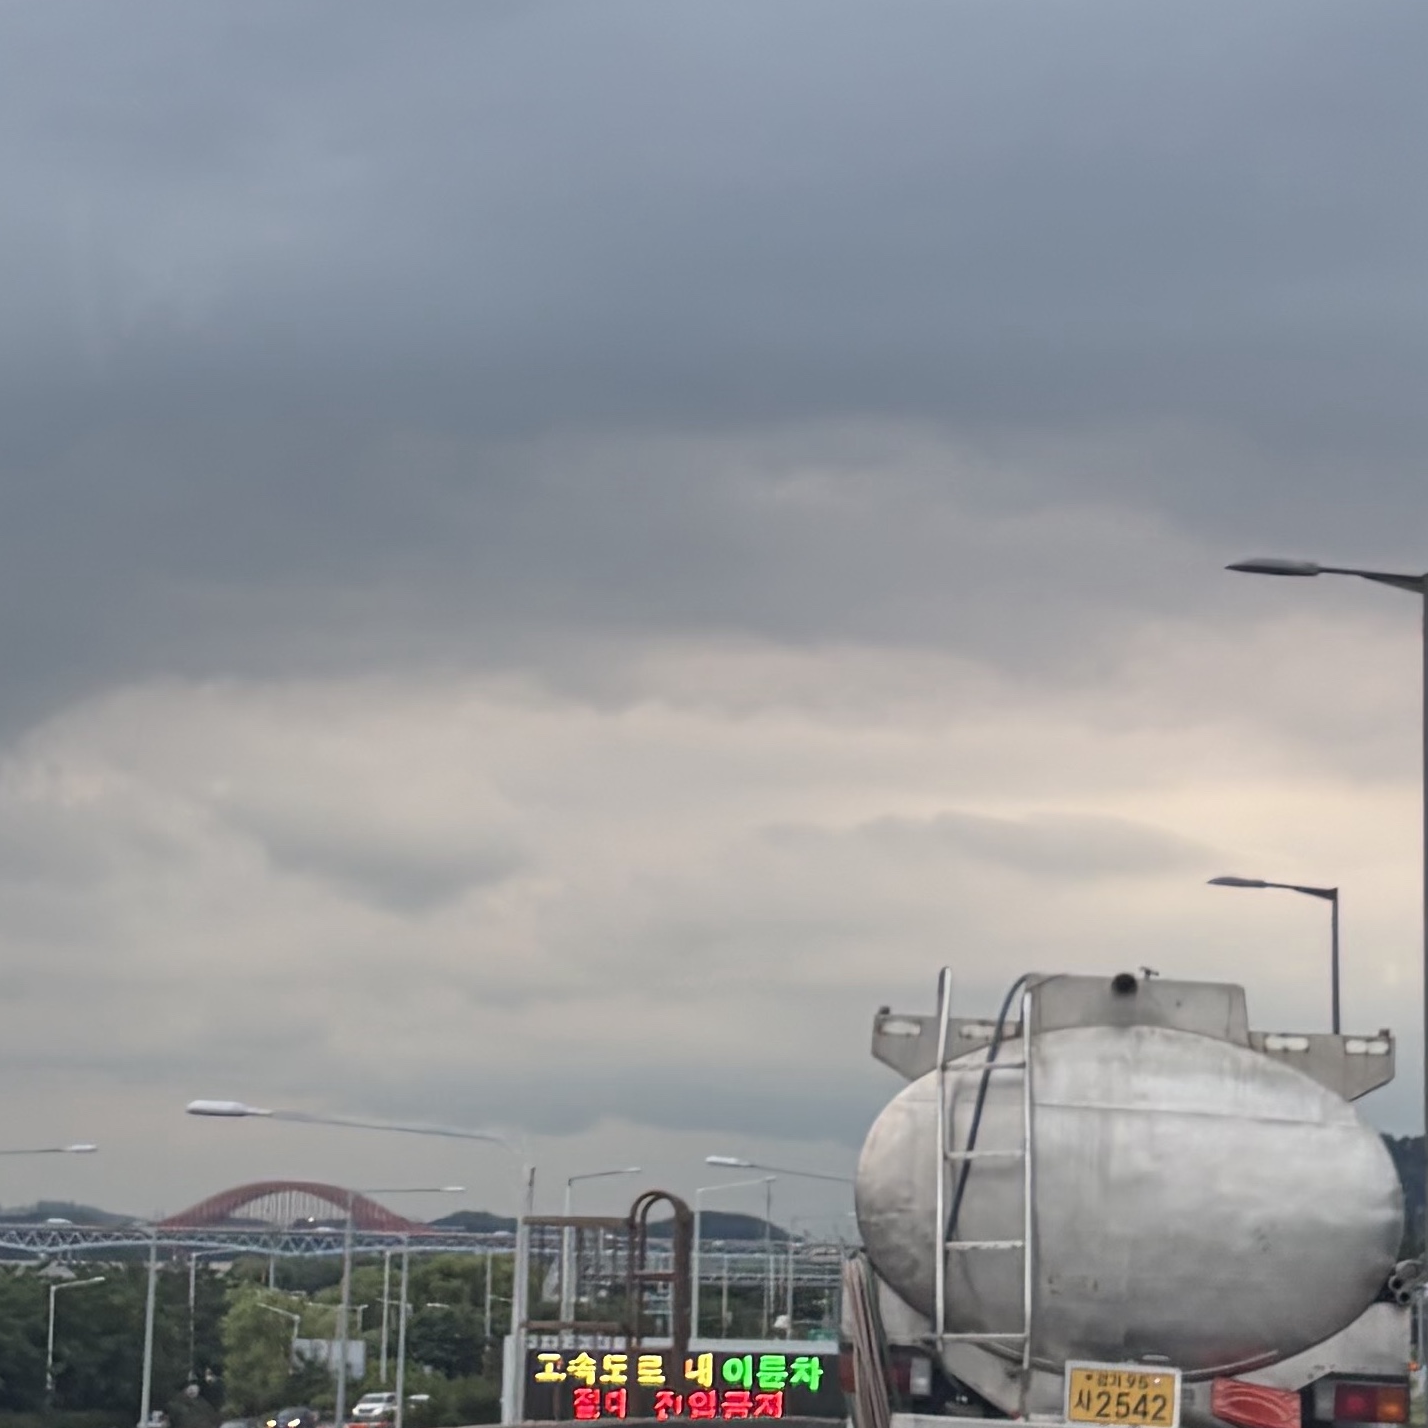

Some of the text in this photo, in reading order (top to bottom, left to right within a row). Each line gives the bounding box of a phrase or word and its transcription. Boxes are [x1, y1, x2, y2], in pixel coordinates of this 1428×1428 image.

[535, 1352, 824, 1392] 고속도로 내 이륜차
